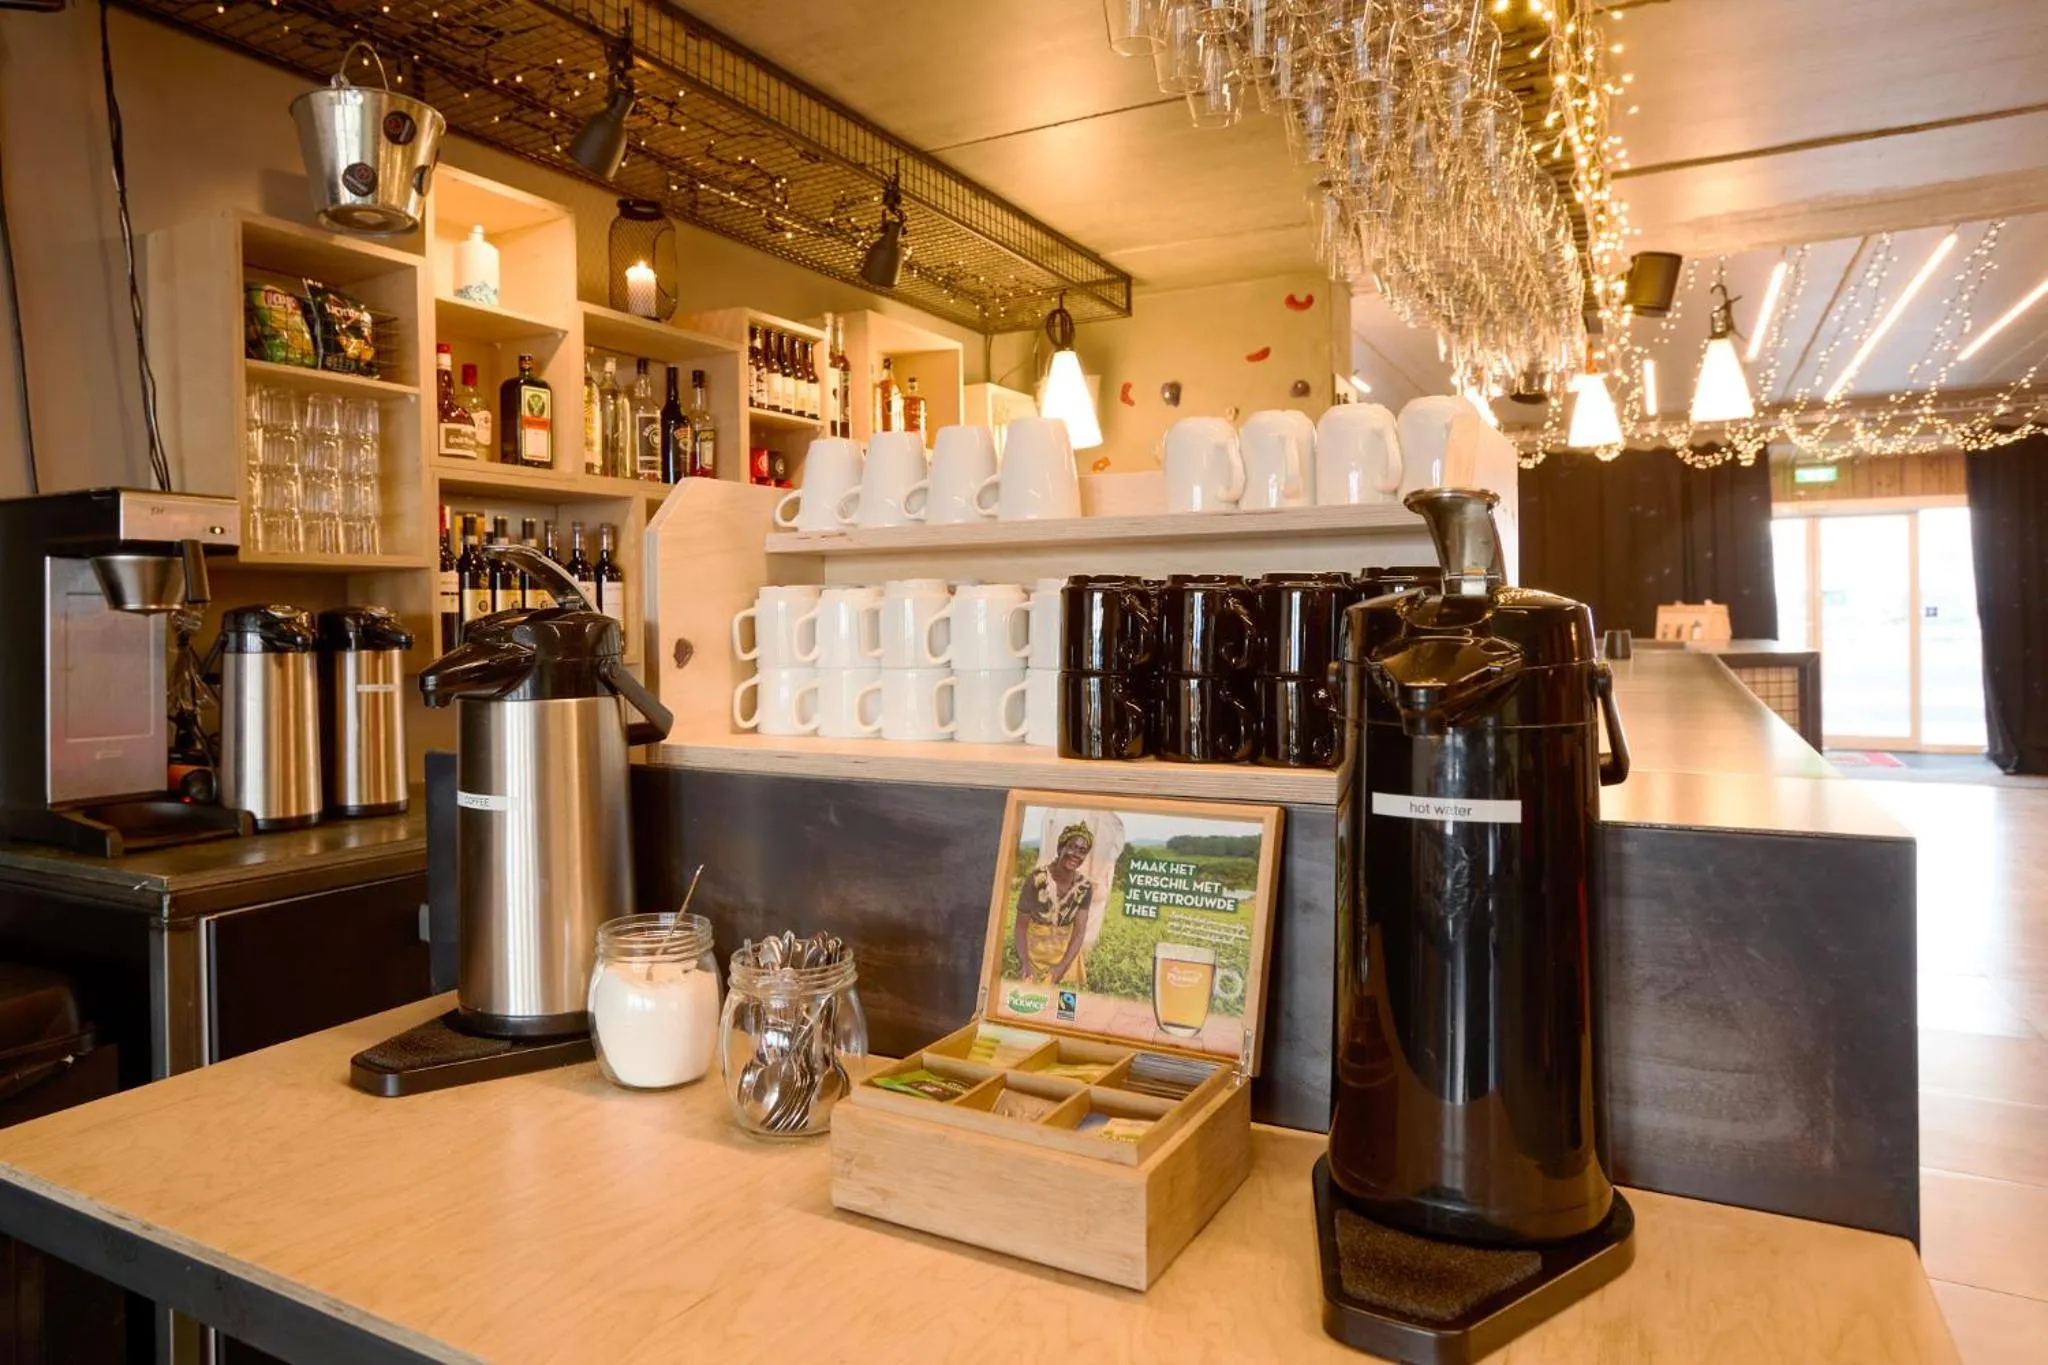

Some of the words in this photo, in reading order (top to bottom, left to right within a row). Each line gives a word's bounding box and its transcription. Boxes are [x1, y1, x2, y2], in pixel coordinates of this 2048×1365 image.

[464, 795, 489, 807] COFFEE
[1409, 800, 1430, 814] hot
[1434, 805, 1473, 817] water
[1130, 860, 1167, 873] MAAK
[1169, 863, 1196, 875] HET
[1128, 874, 1190, 891] VERSCHIL
[1192, 881, 1222, 894] MET
[1126, 888, 1141, 901] JE
[1144, 890, 1236, 911] VERTROUWDE
[1124, 903, 1157, 918] THEE
